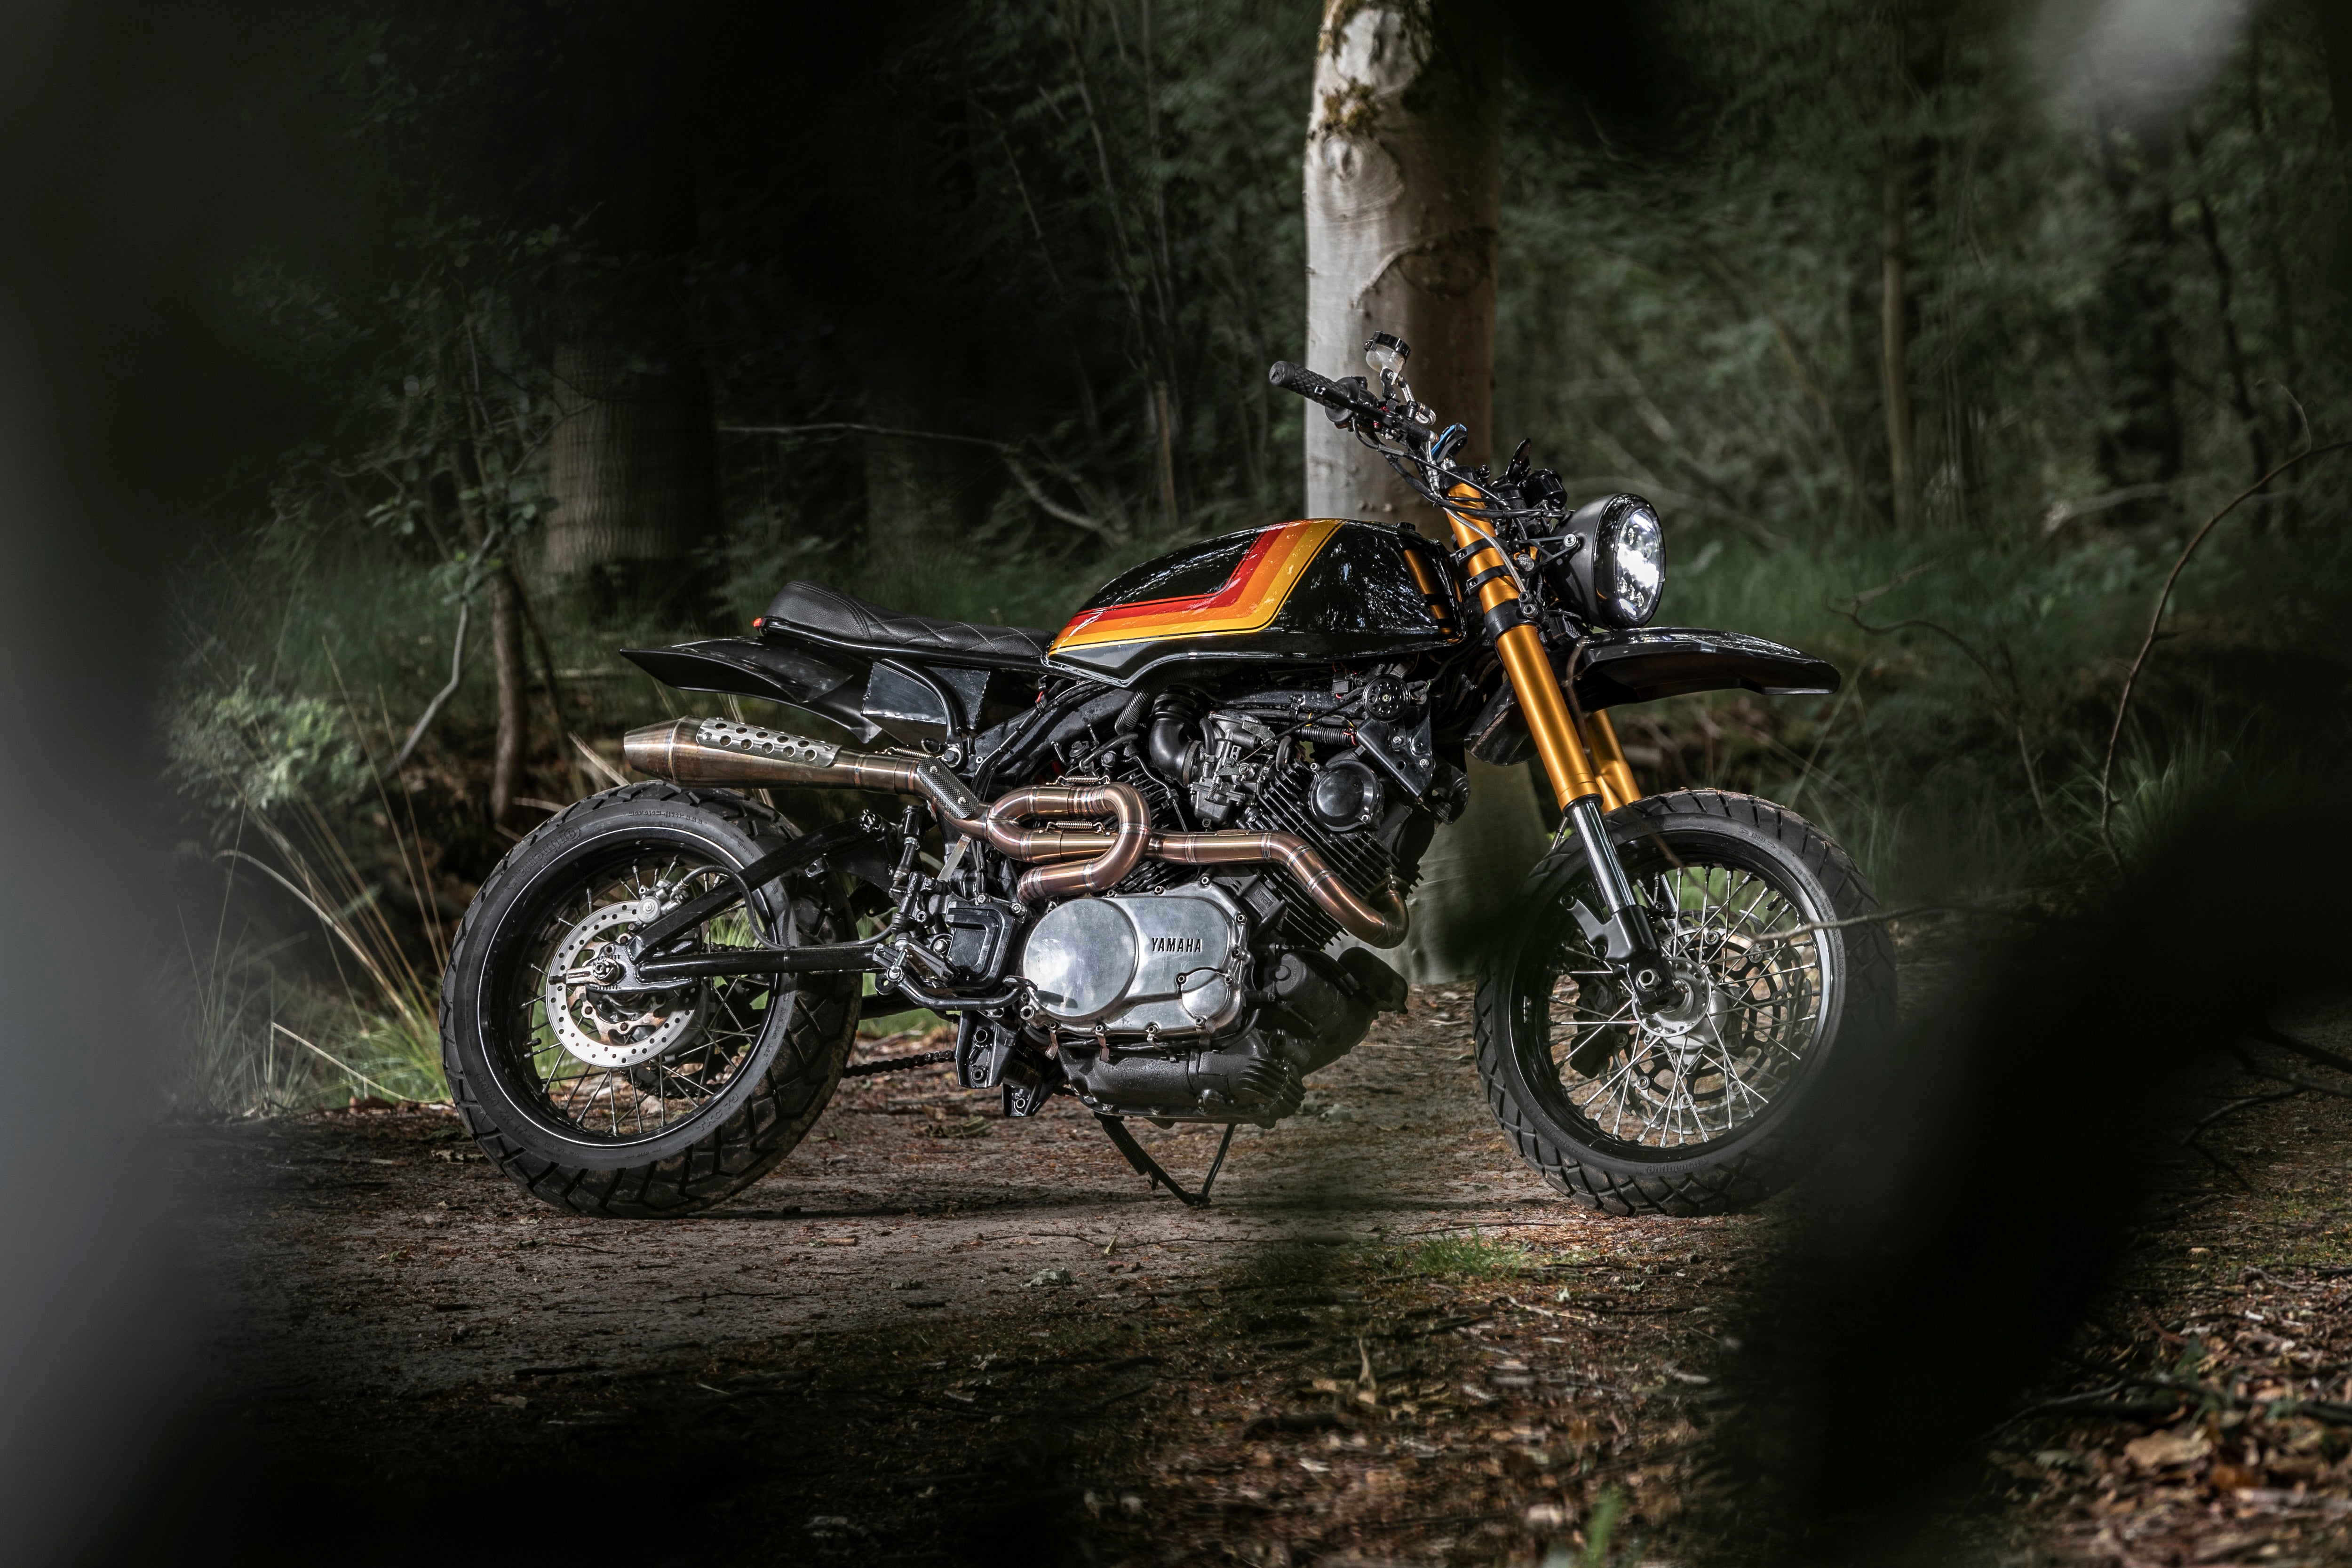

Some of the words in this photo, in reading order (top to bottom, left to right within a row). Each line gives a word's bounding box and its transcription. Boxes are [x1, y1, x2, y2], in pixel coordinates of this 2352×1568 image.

[628, 810, 703, 824] www.conti-moto.com
[511, 825, 582, 884] Continental
[1152, 937, 1202, 953] YAMAHA
[695, 1107, 724, 1134] TKC
[723, 1092, 740, 1110] 70
